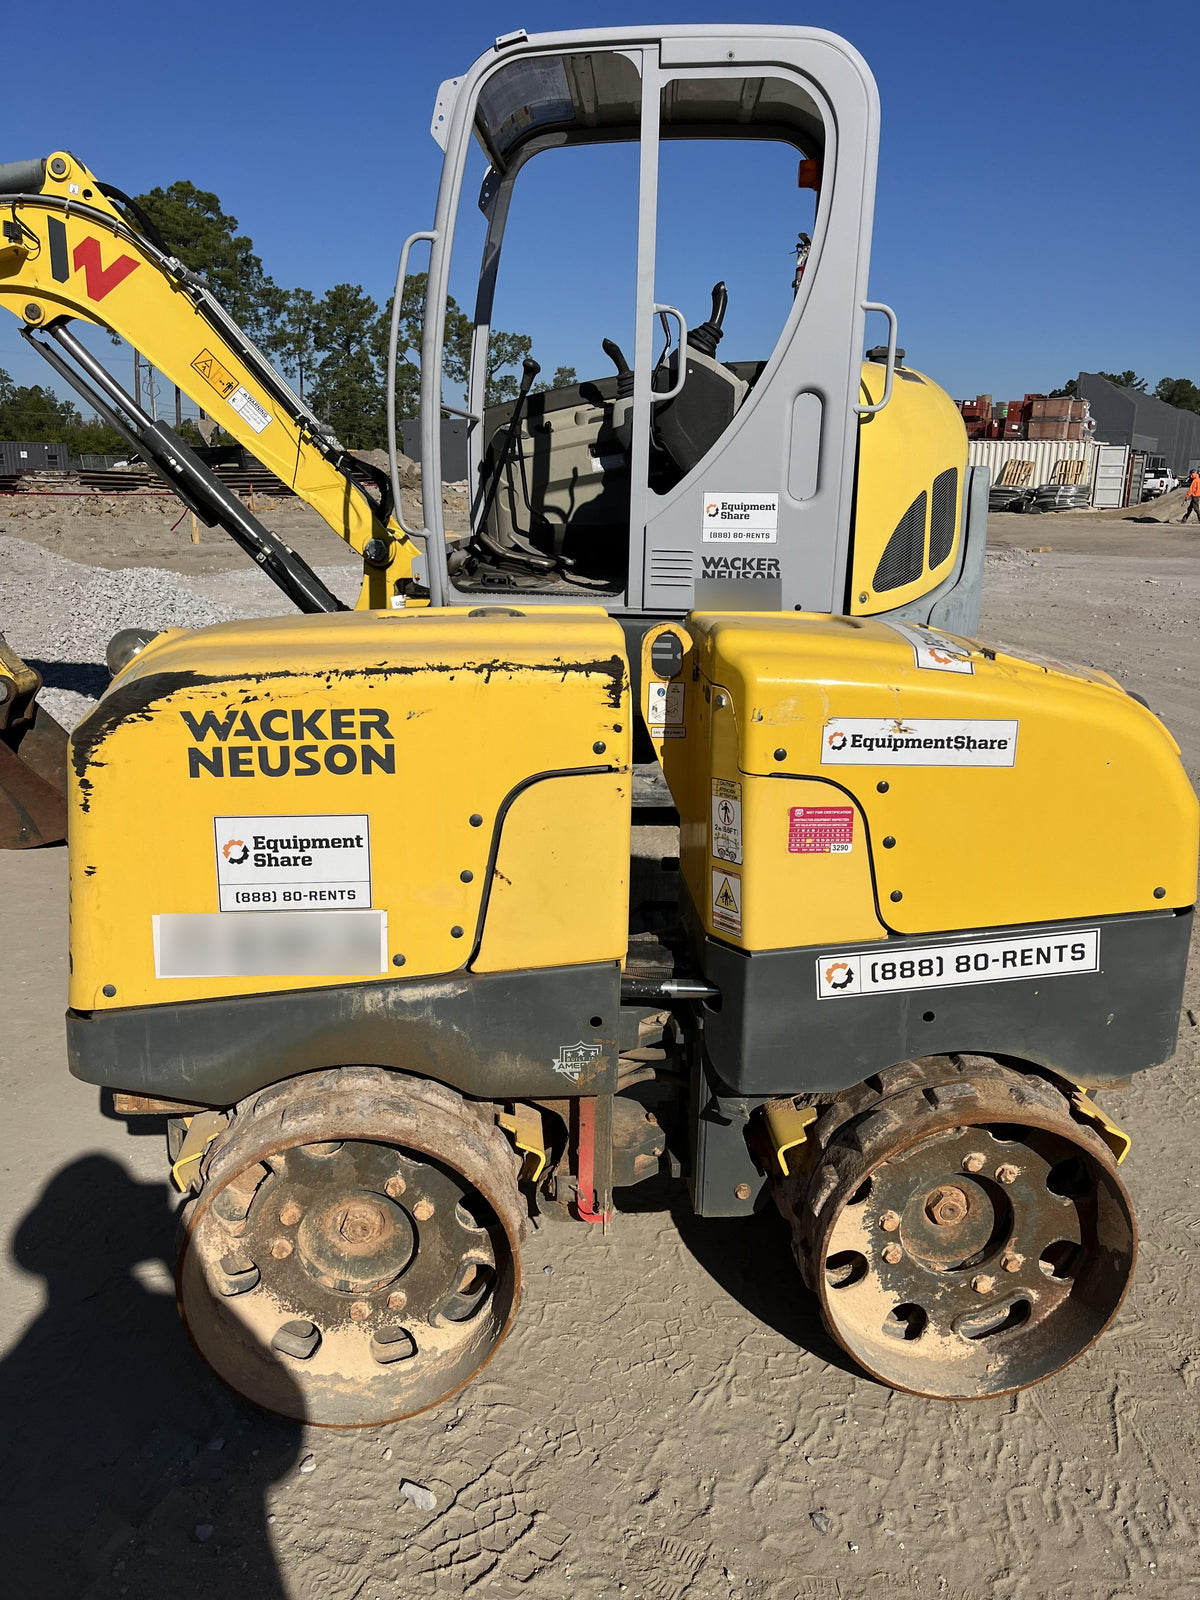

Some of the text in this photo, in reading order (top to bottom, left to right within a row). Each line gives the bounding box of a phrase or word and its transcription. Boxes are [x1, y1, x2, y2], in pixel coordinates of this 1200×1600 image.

[721, 502, 776, 512] Equipment
[720, 511, 750, 520] Share
[709, 531, 731, 539] (888)
[701, 556, 781, 571] WACKER
[179, 708, 395, 742] WACKER
[851, 734, 1008, 751] EquipmentShare
[187, 744, 396, 778] NEUSON
[252, 835, 364, 852] Equipment
[253, 853, 313, 868] Share
[235, 890, 356, 903] (888) 80-RENTS
[871, 943, 1086, 983] (888) 80-RENTS
